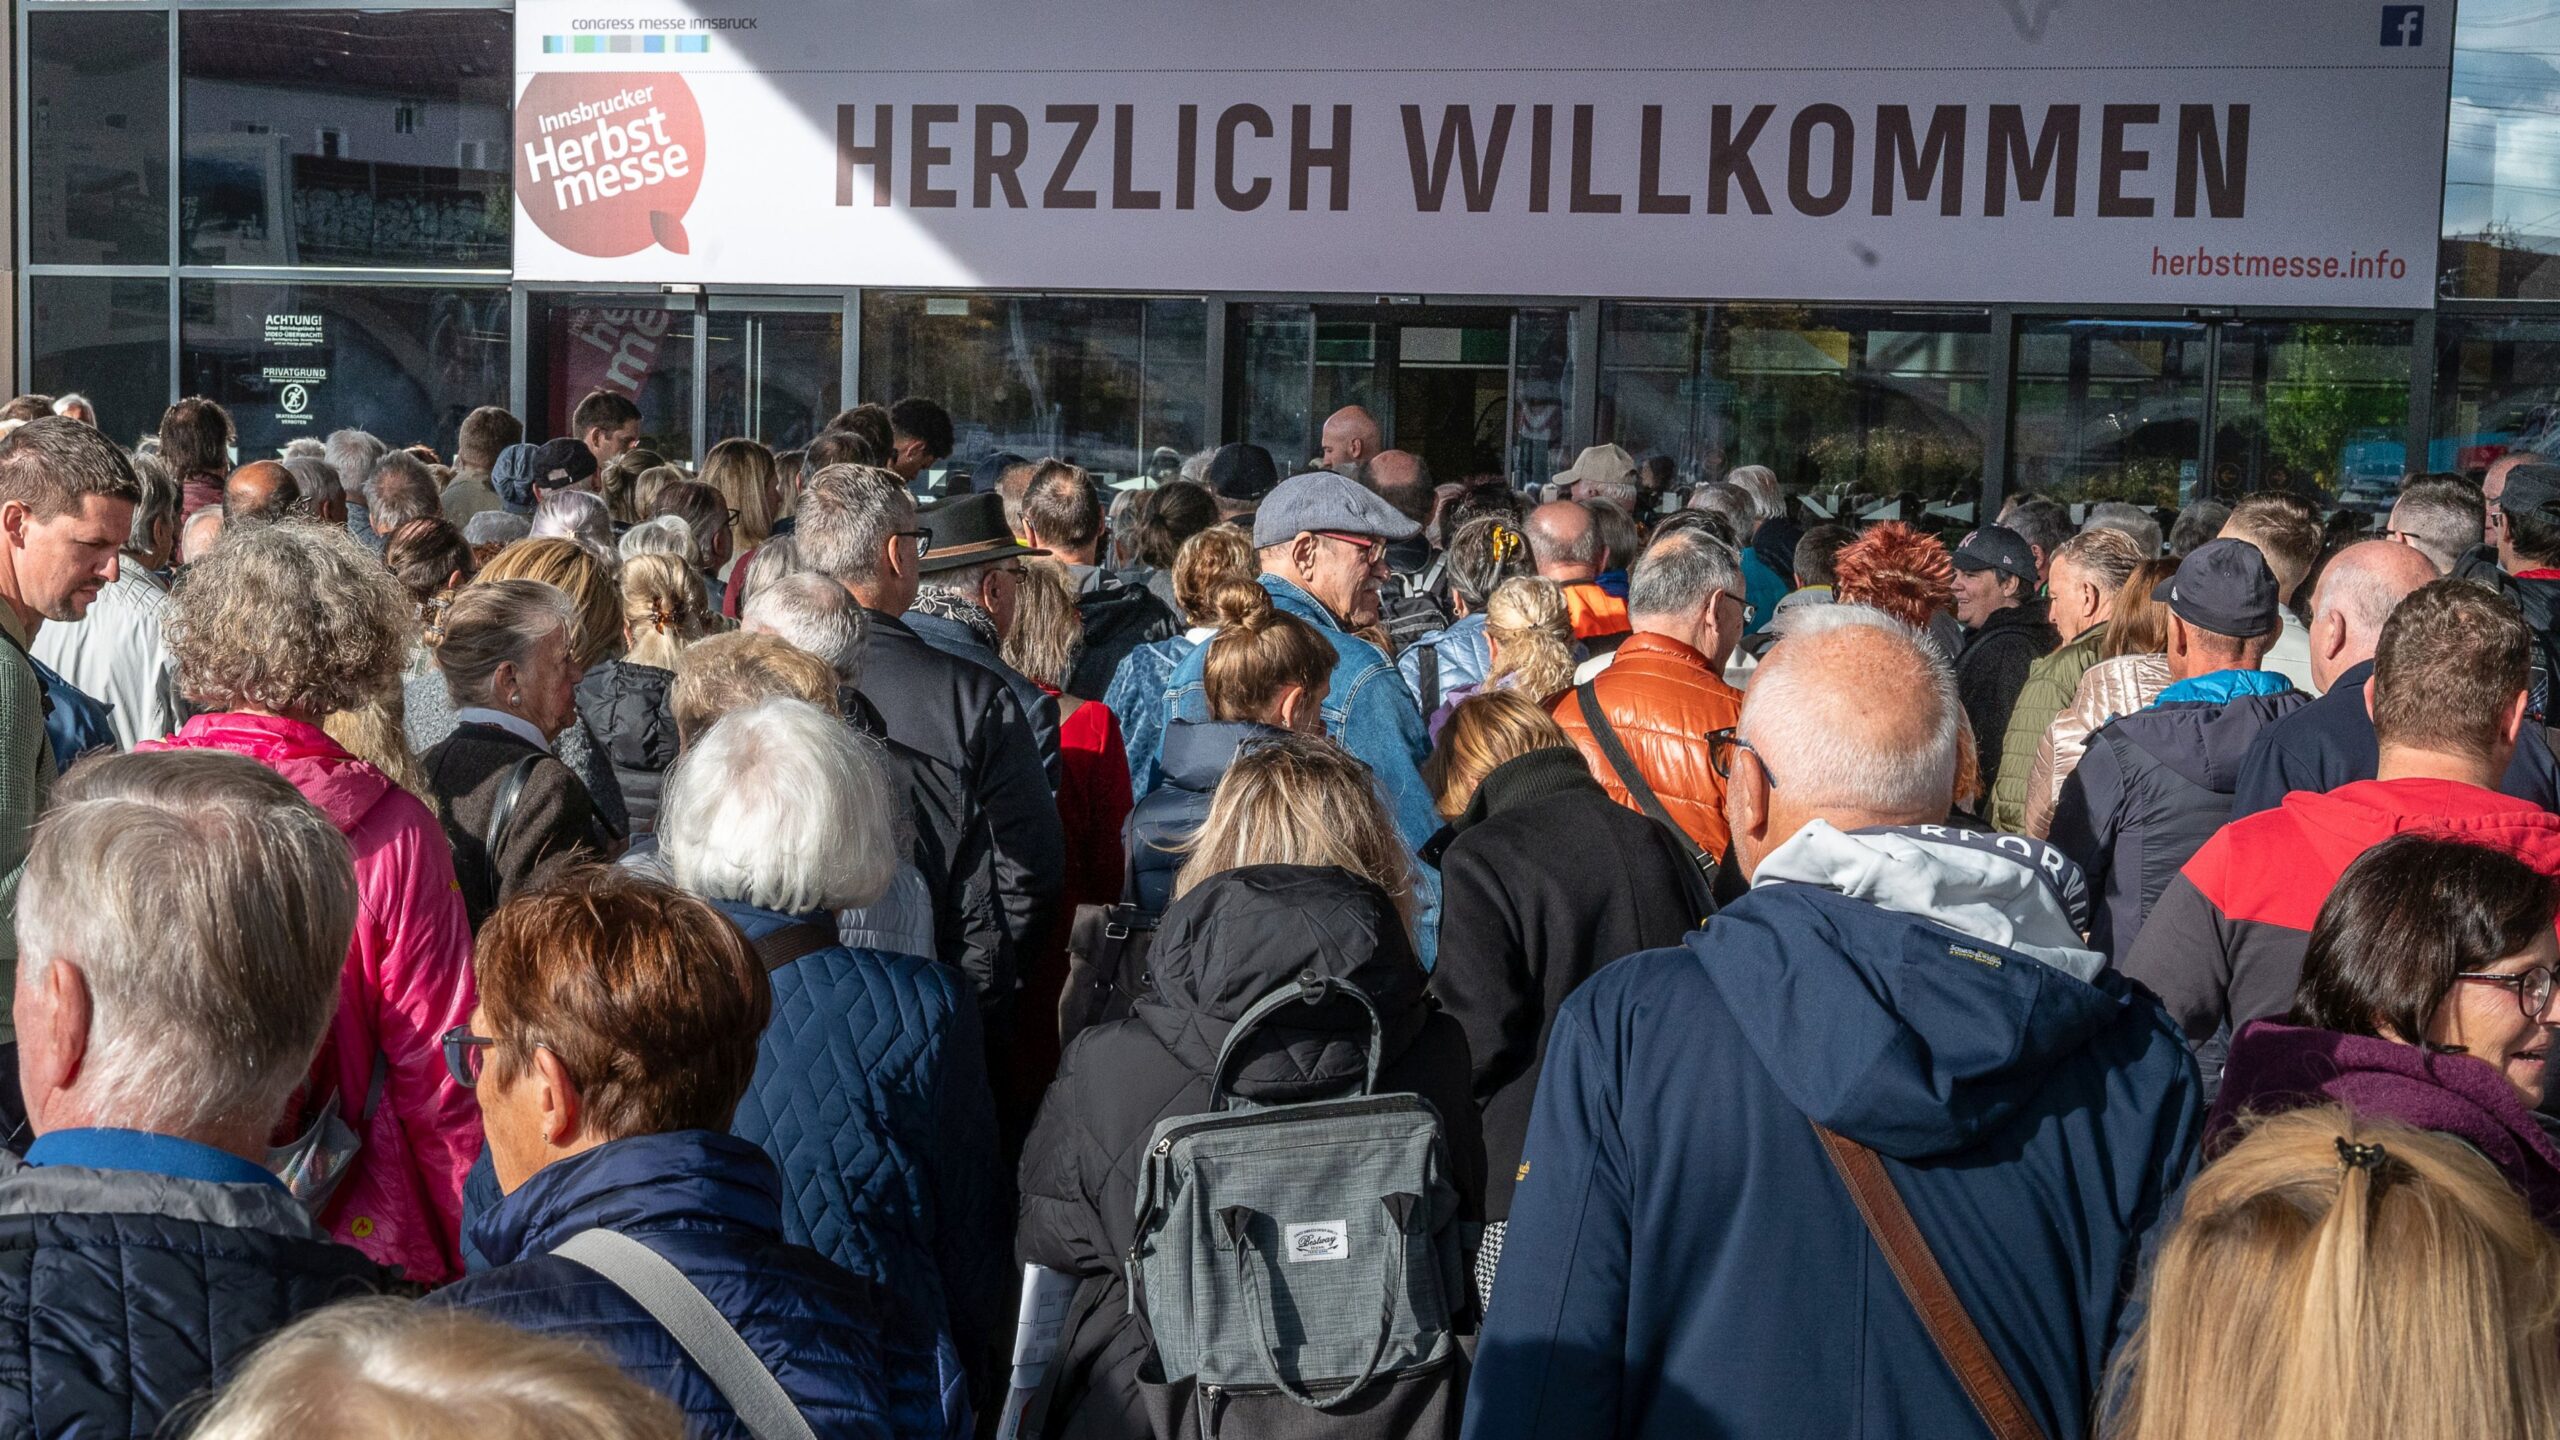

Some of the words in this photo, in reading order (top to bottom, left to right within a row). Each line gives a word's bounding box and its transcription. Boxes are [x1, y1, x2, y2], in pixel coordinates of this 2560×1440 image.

[638, 17, 686, 30] messe
[538, 86, 653, 134] Innsbrucker
[524, 106, 672, 183] Herbst
[835, 102, 1353, 212] HERZLICH
[1400, 102, 2251, 218] WILLKOMMEN
[553, 143, 689, 211] messe
[2151, 246, 2407, 279] herbstmesse.info
[265, 314, 323, 325] ACHTUNG!
[263, 367, 326, 377] PRIVATGRUND
